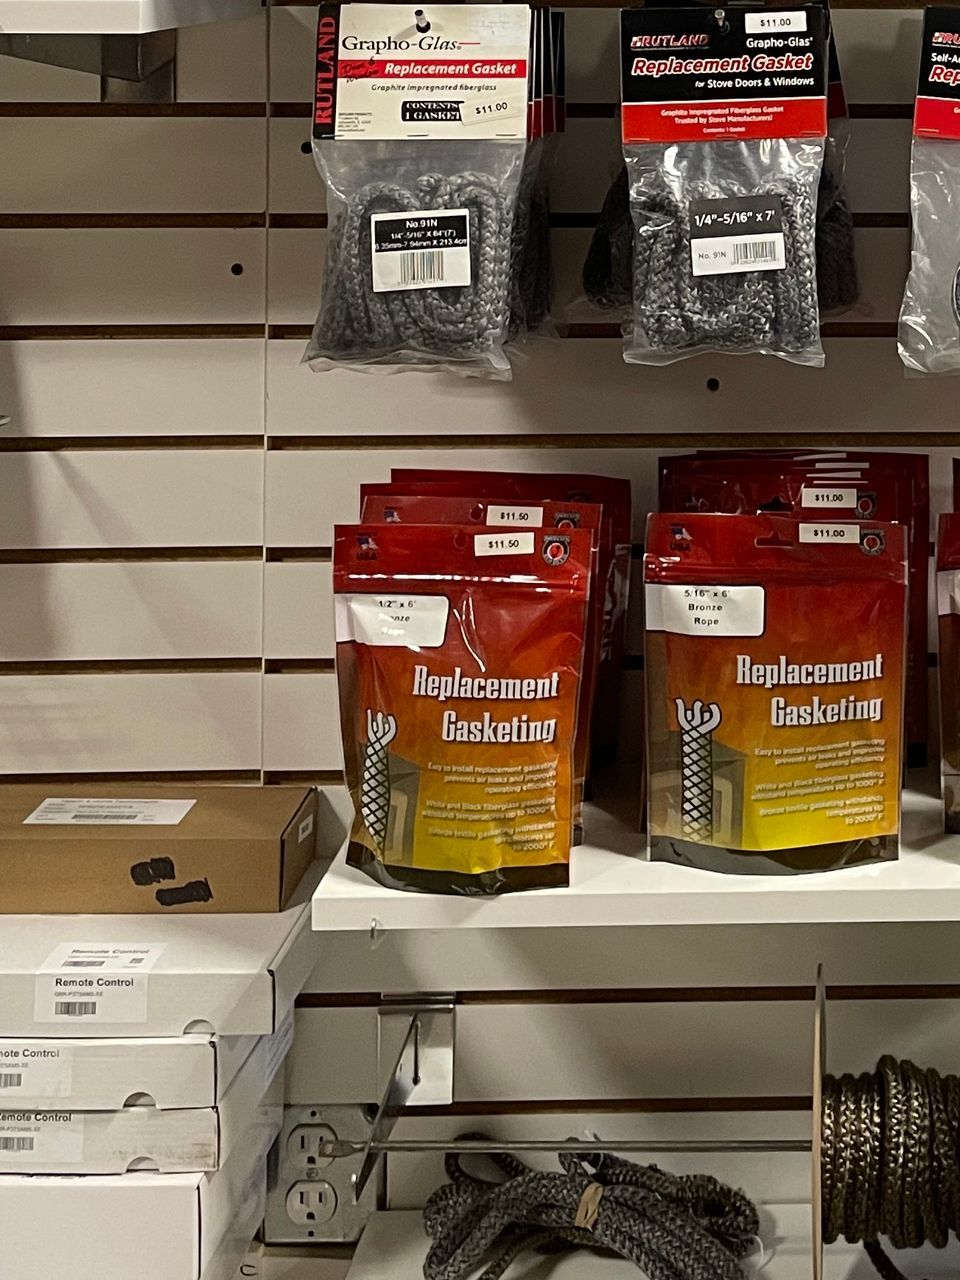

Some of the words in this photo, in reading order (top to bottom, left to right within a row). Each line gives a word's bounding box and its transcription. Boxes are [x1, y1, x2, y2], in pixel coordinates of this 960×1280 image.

[759, 18, 791, 27] $11.00
[641, 34, 709, 47] RUTLAND
[385, 62, 468, 77] Replacement
[472, 63, 517, 75] Gasket
[631, 55, 750, 77] Replacement
[751, 53, 813, 72] Gasket
[315, 16, 336, 125] RUTLAND
[475, 102, 508, 115] $11.00
[815, 494, 844, 502] $11.00
[500, 511, 529, 520] $11.50
[813, 529, 845, 538] $11.00
[488, 539, 519, 549] $11.50
[688, 603, 723, 611] Bronze
[694, 617, 719, 627] Rope
[736, 652, 883, 688] Replacement
[412, 664, 560, 702] Replacement
[771, 694, 883, 728] Gasketing
[441, 710, 556, 744] Gasketing
[55, 978, 94, 987] Remote
[97, 978, 134, 987] Control
[22, 1049, 60, 1058] Control
[34, 1112, 72, 1122] Control
